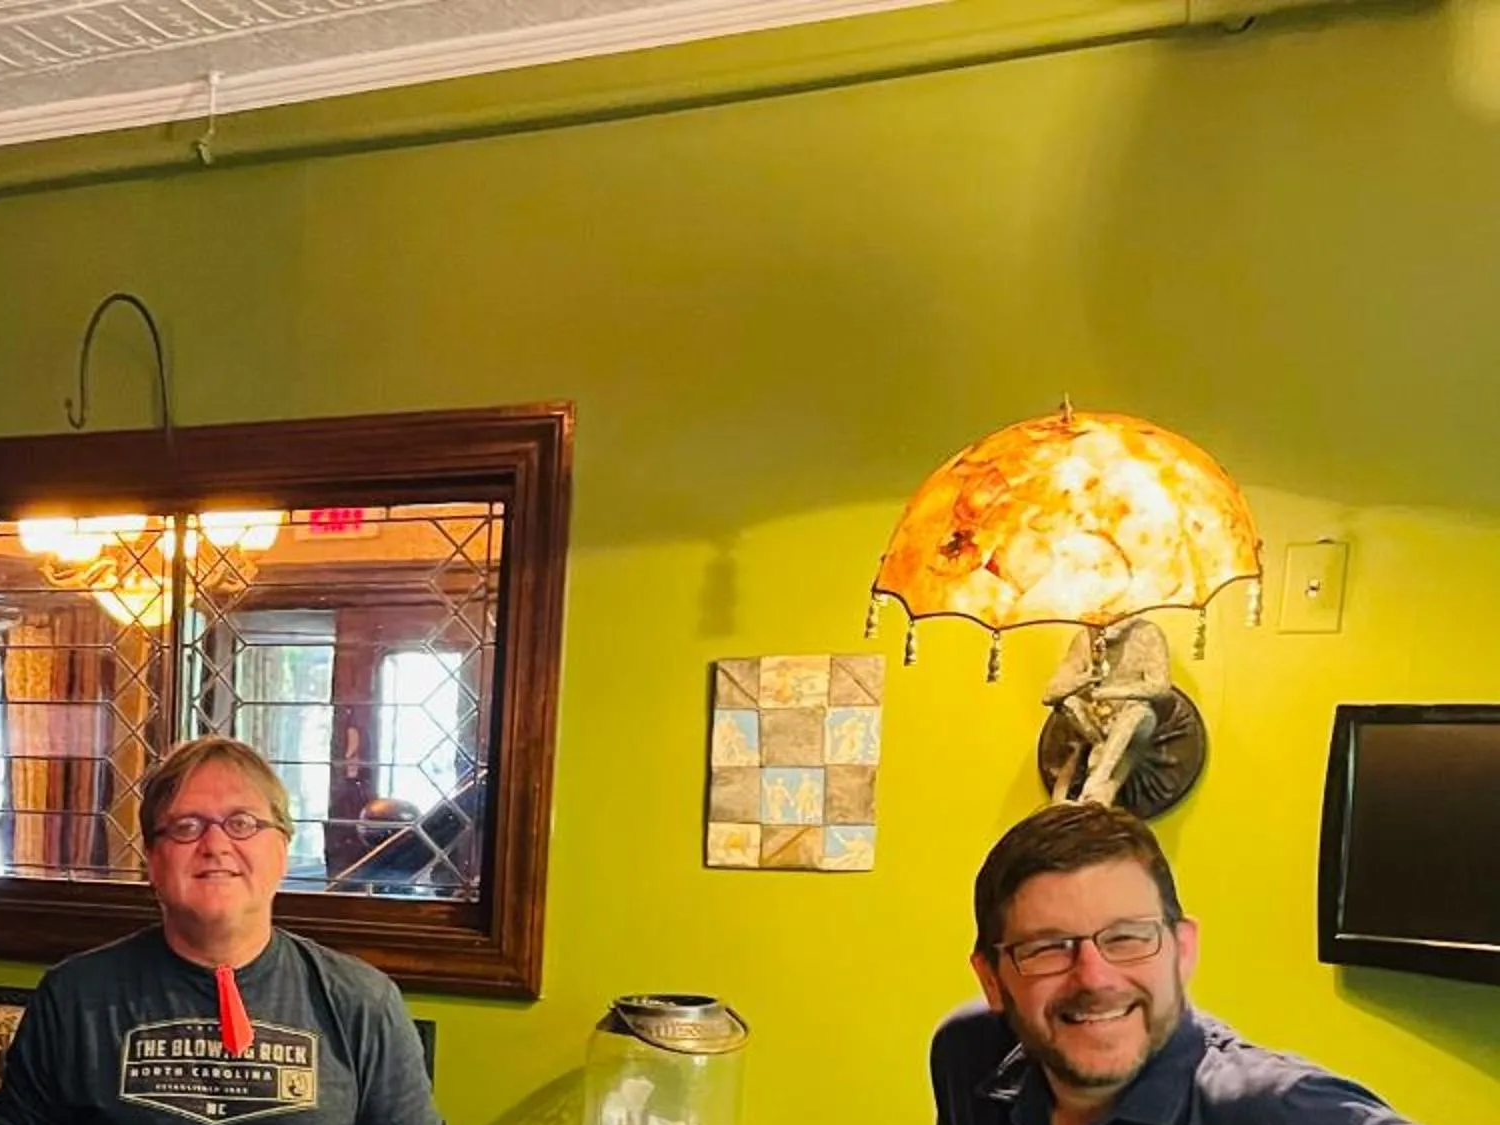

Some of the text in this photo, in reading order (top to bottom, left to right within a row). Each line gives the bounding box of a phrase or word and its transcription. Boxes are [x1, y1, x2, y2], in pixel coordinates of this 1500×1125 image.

[135, 1038, 308, 1065] THE BLOWG ROCK
[130, 1066, 273, 1081] NORTH CAROLINA
[205, 1101, 227, 1116] NC
